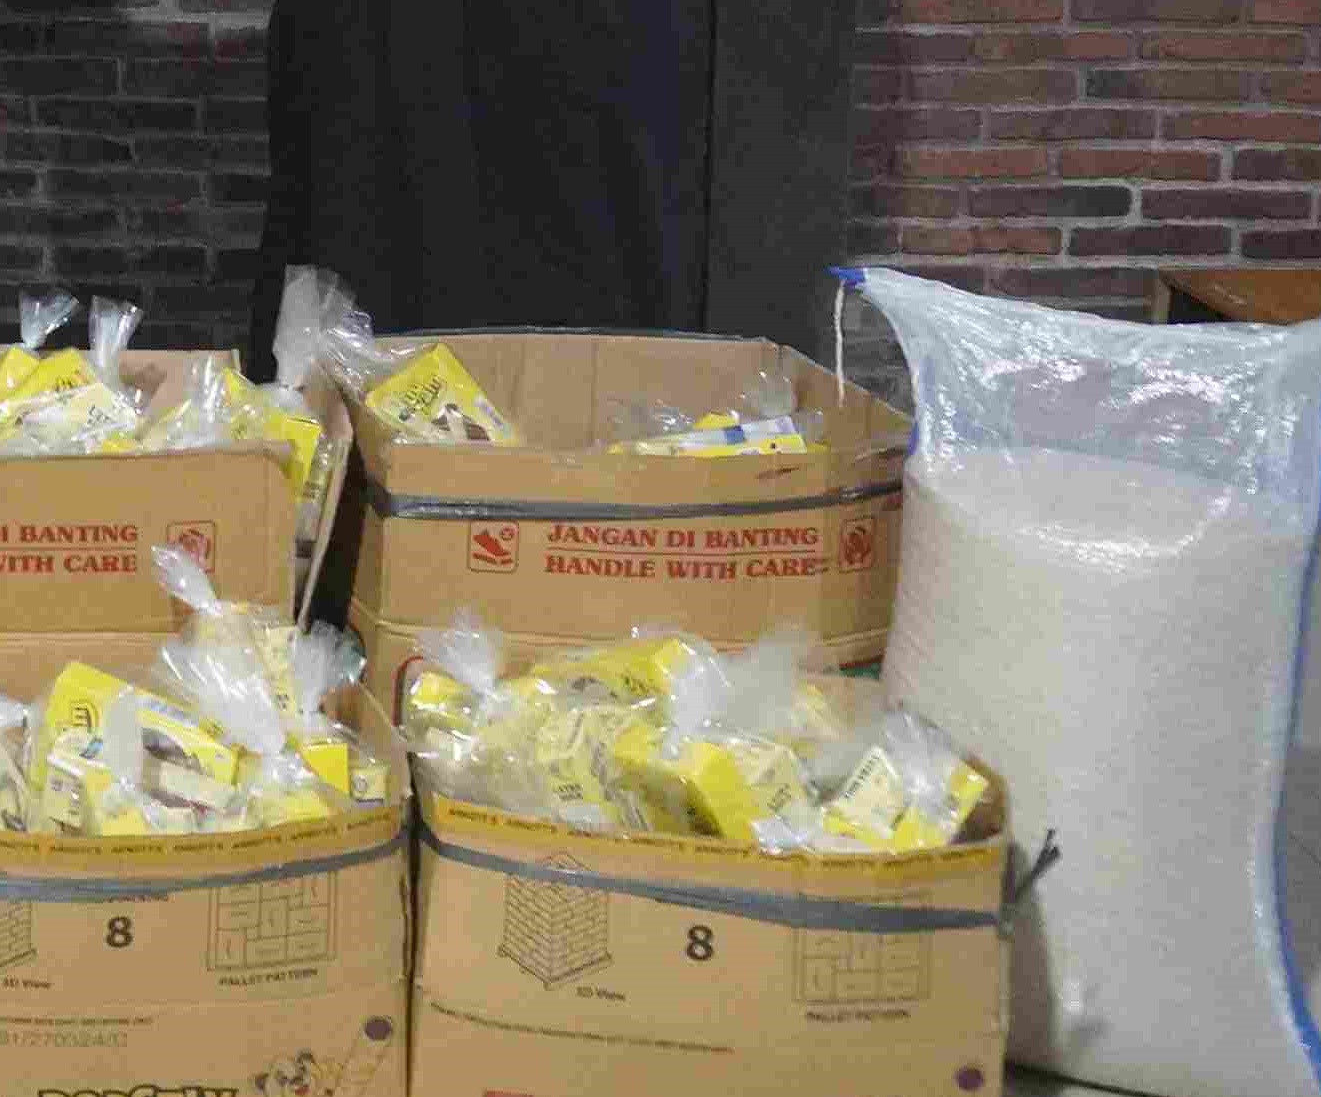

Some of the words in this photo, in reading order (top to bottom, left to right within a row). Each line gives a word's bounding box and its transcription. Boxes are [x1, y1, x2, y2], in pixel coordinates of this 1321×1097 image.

[19, 523, 139, 545] BANTING
[546, 524, 659, 548] JANGAN
[666, 526, 695, 548] DI
[705, 526, 820, 548] BANTING
[63, 553, 139, 574] CARE
[543, 554, 656, 579] HANDLE
[666, 557, 737, 580] WITH
[745, 556, 820, 578] CARE
[105, 916, 134, 949] 8
[686, 925, 715, 962] 8
